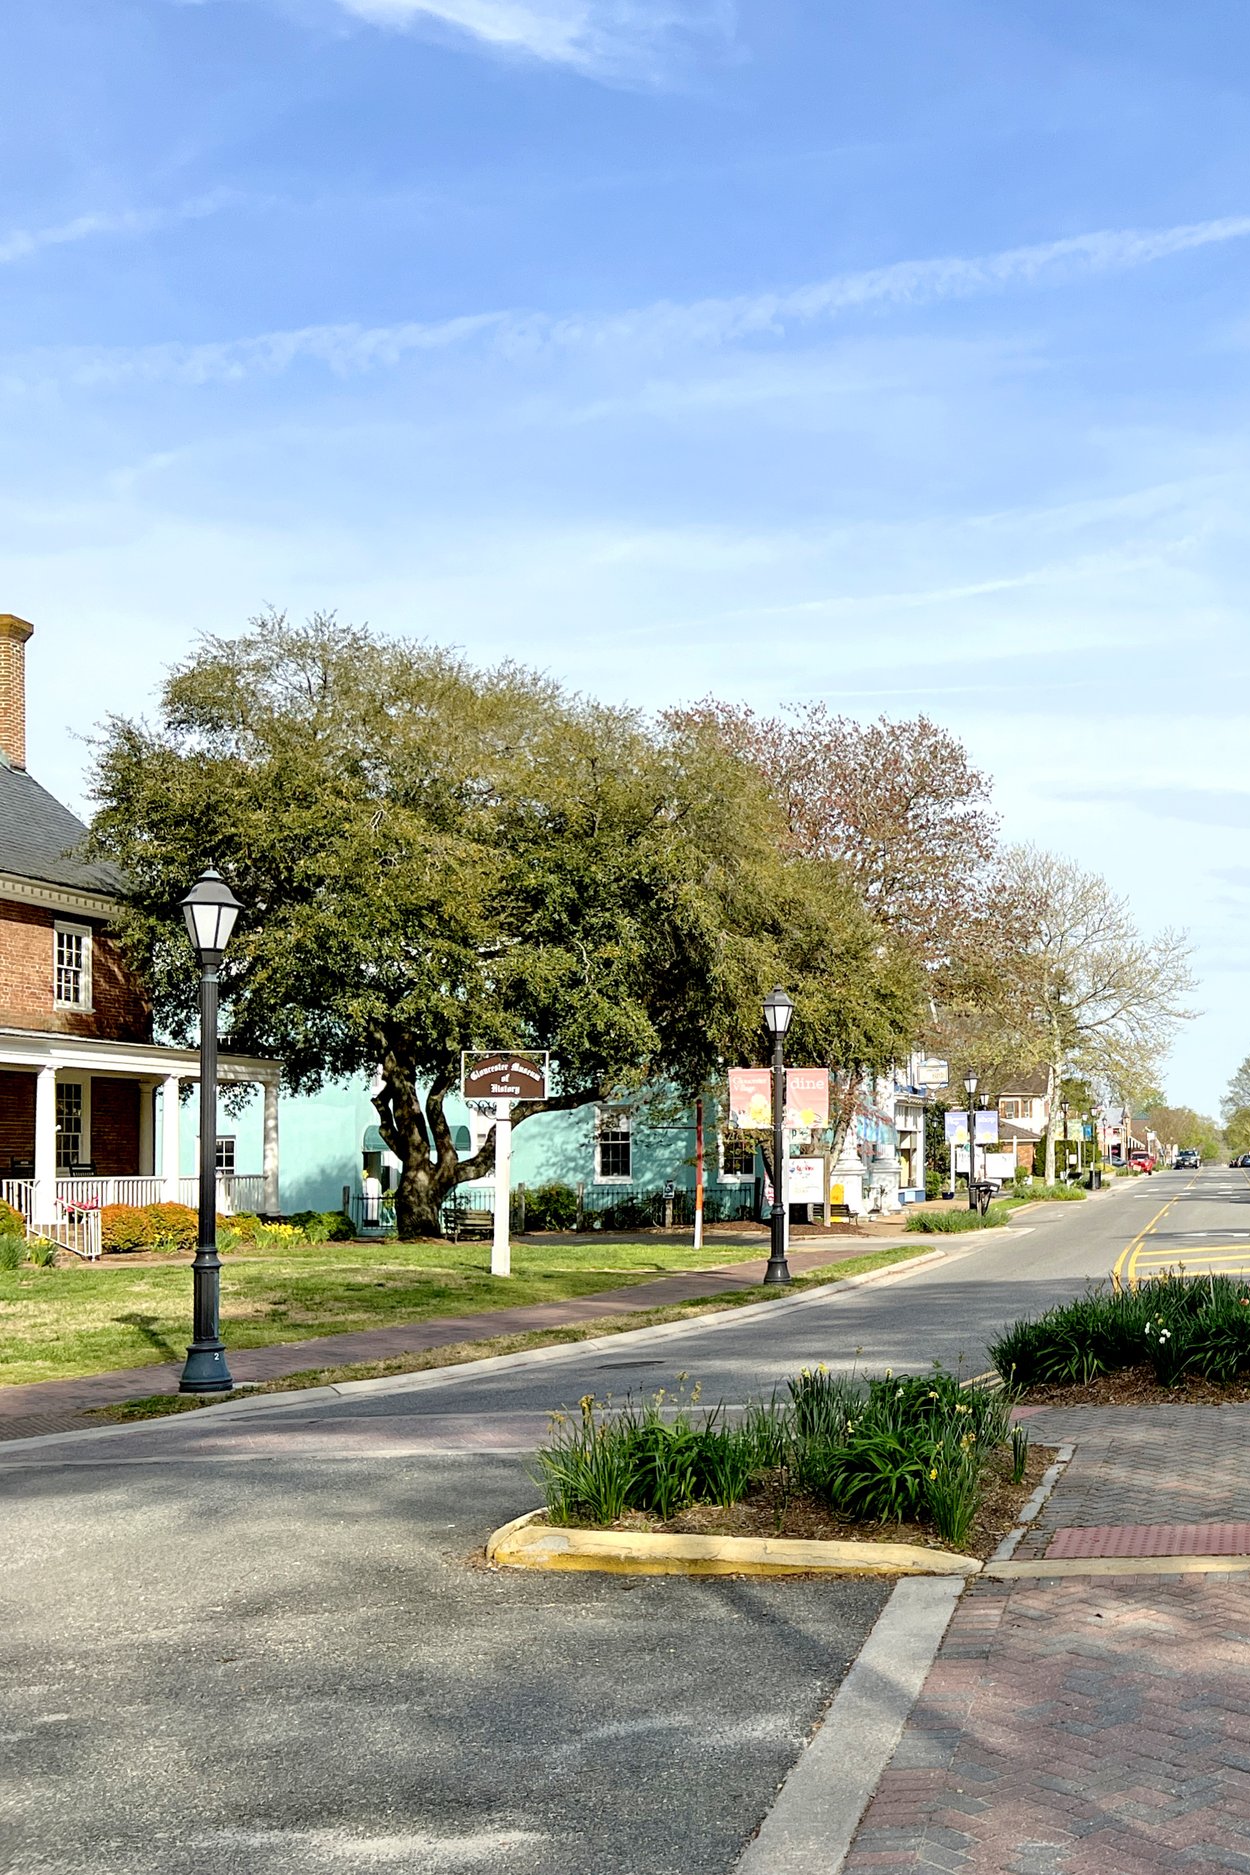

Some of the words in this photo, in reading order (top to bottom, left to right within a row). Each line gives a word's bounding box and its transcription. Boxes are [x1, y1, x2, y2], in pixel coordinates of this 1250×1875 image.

[470, 1063, 509, 1081] Gloucester
[510, 1062, 541, 1081] Museum
[501, 1073, 510, 1082] of
[491, 1084, 520, 1094] History
[790, 1077, 825, 1090] dine
